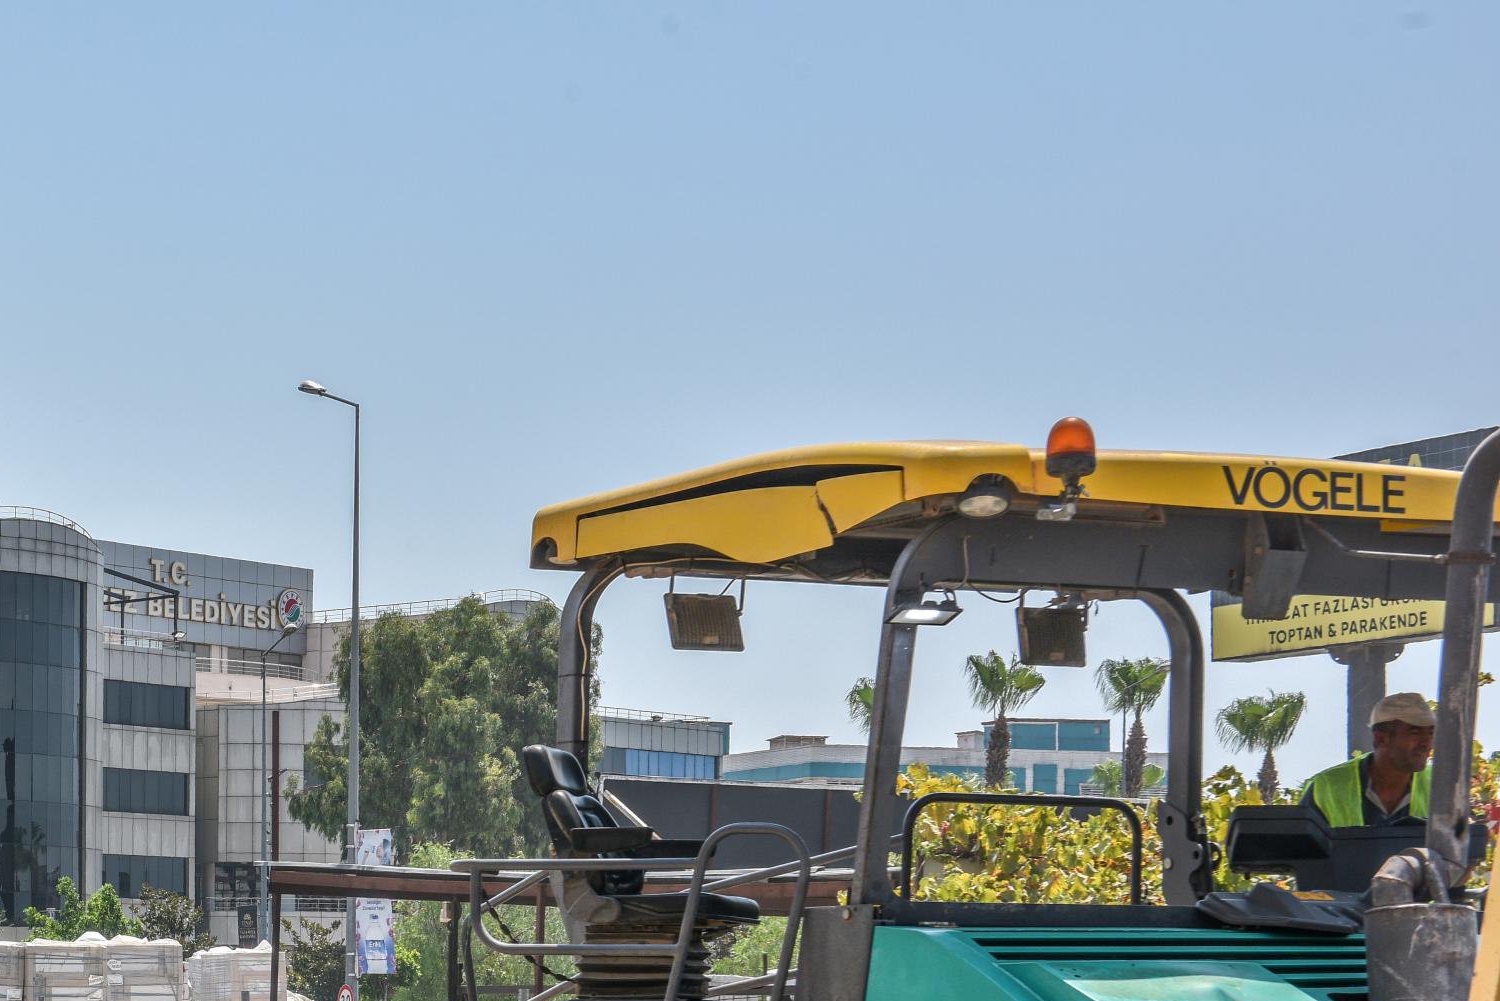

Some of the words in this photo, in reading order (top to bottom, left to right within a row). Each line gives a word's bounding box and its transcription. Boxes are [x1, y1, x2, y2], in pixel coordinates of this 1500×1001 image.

[1221, 460, 1407, 515] VÖGELE
[149, 558, 191, 587] T.C.
[148, 591, 277, 630] BELEDİYESİ
[1268, 625, 1323, 645] TOPTAN
[1328, 622, 1337, 638] &
[1341, 611, 1428, 636] PARAKENDE
